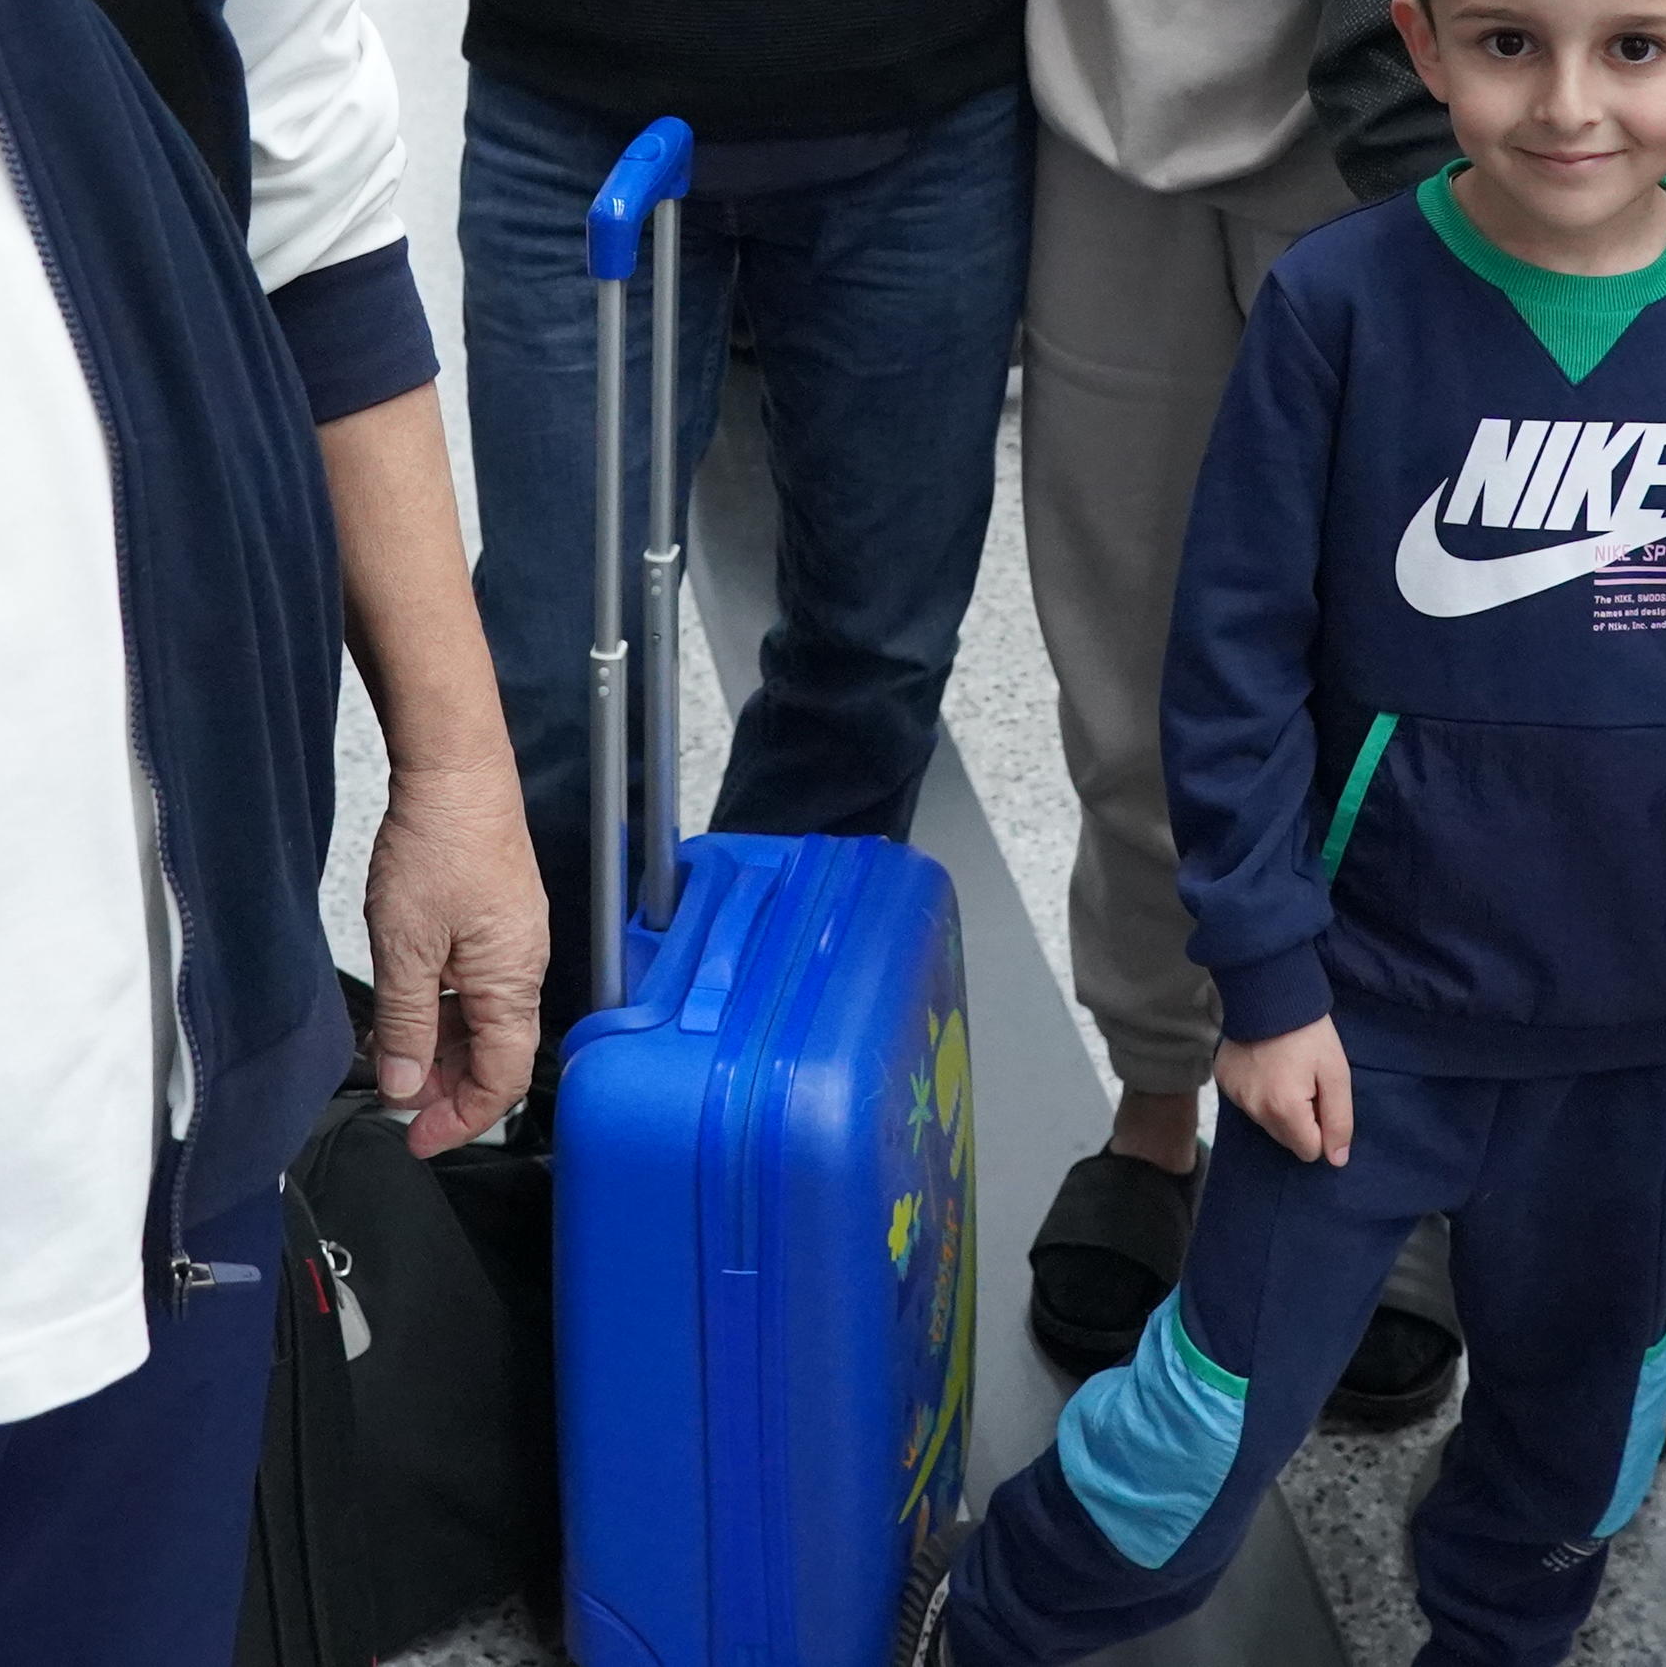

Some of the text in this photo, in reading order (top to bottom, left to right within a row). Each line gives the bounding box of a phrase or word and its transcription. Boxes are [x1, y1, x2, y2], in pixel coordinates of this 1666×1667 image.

[1595, 543, 1631, 562] NIKE
[1594, 595, 1612, 604] The
[1593, 609, 1623, 618] names
[1624, 607, 1639, 617] and
[1650, 619, 1666, 629] and
